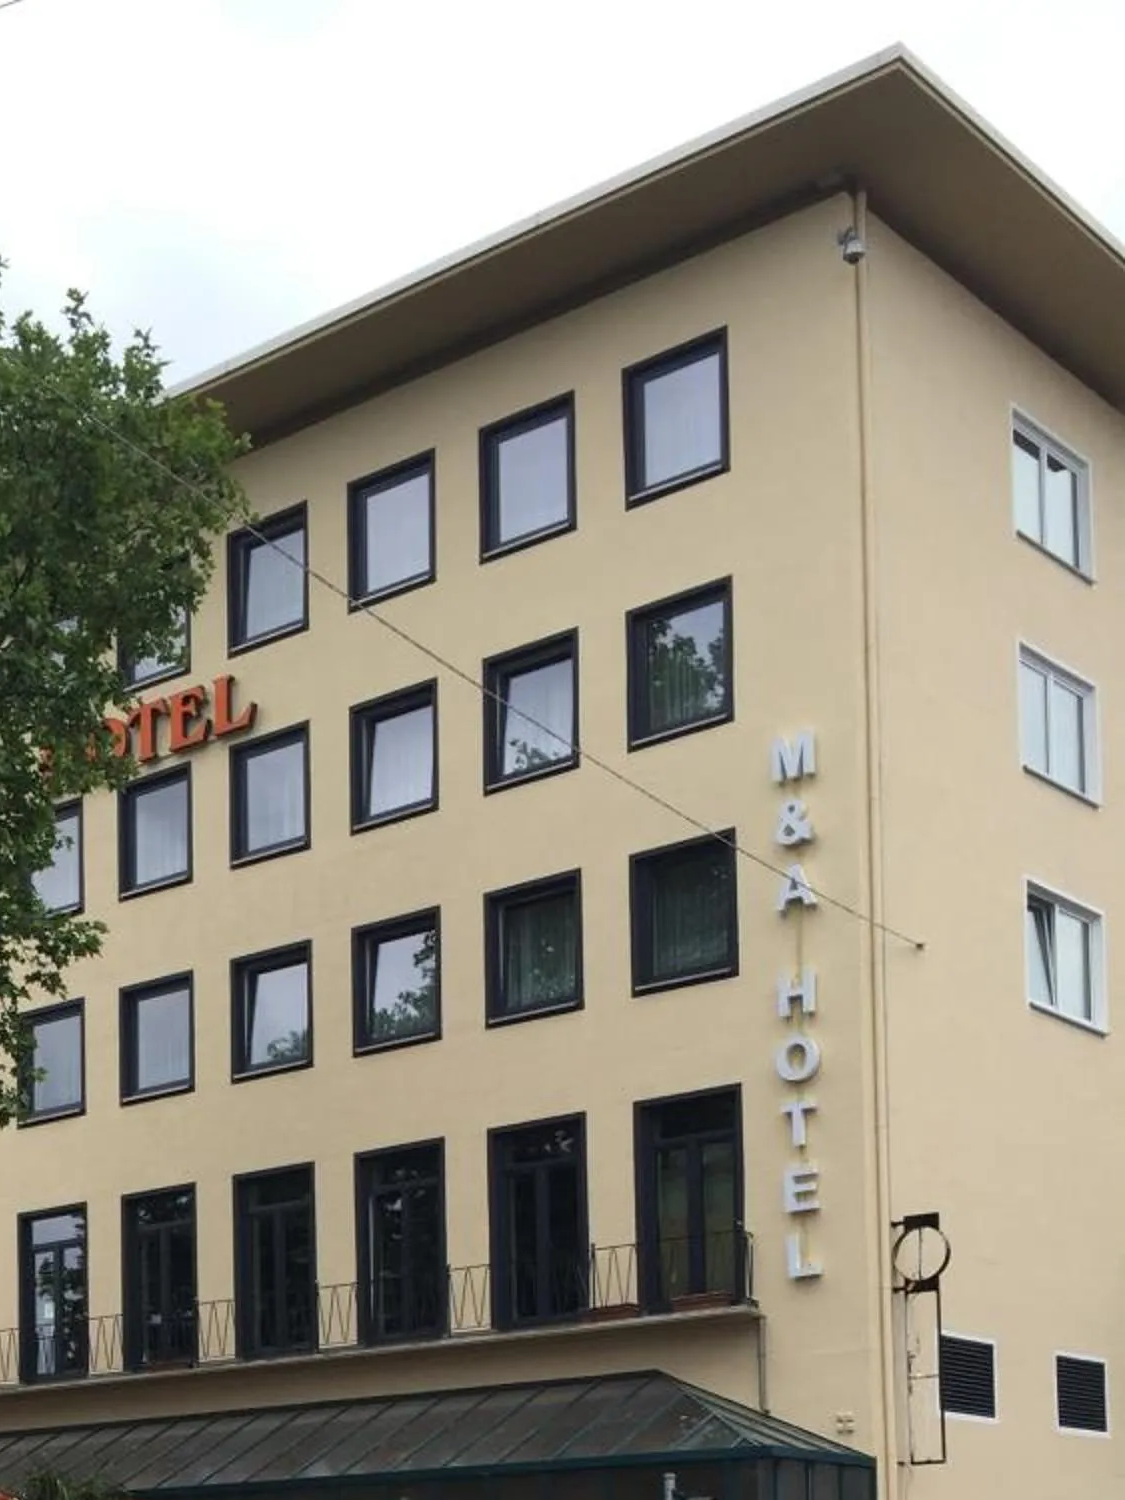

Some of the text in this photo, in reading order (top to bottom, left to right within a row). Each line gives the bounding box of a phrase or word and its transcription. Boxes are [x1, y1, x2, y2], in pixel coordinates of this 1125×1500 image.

[38, 673, 259, 790] OTEL
[771, 730, 822, 1281] M&A HOTEL
